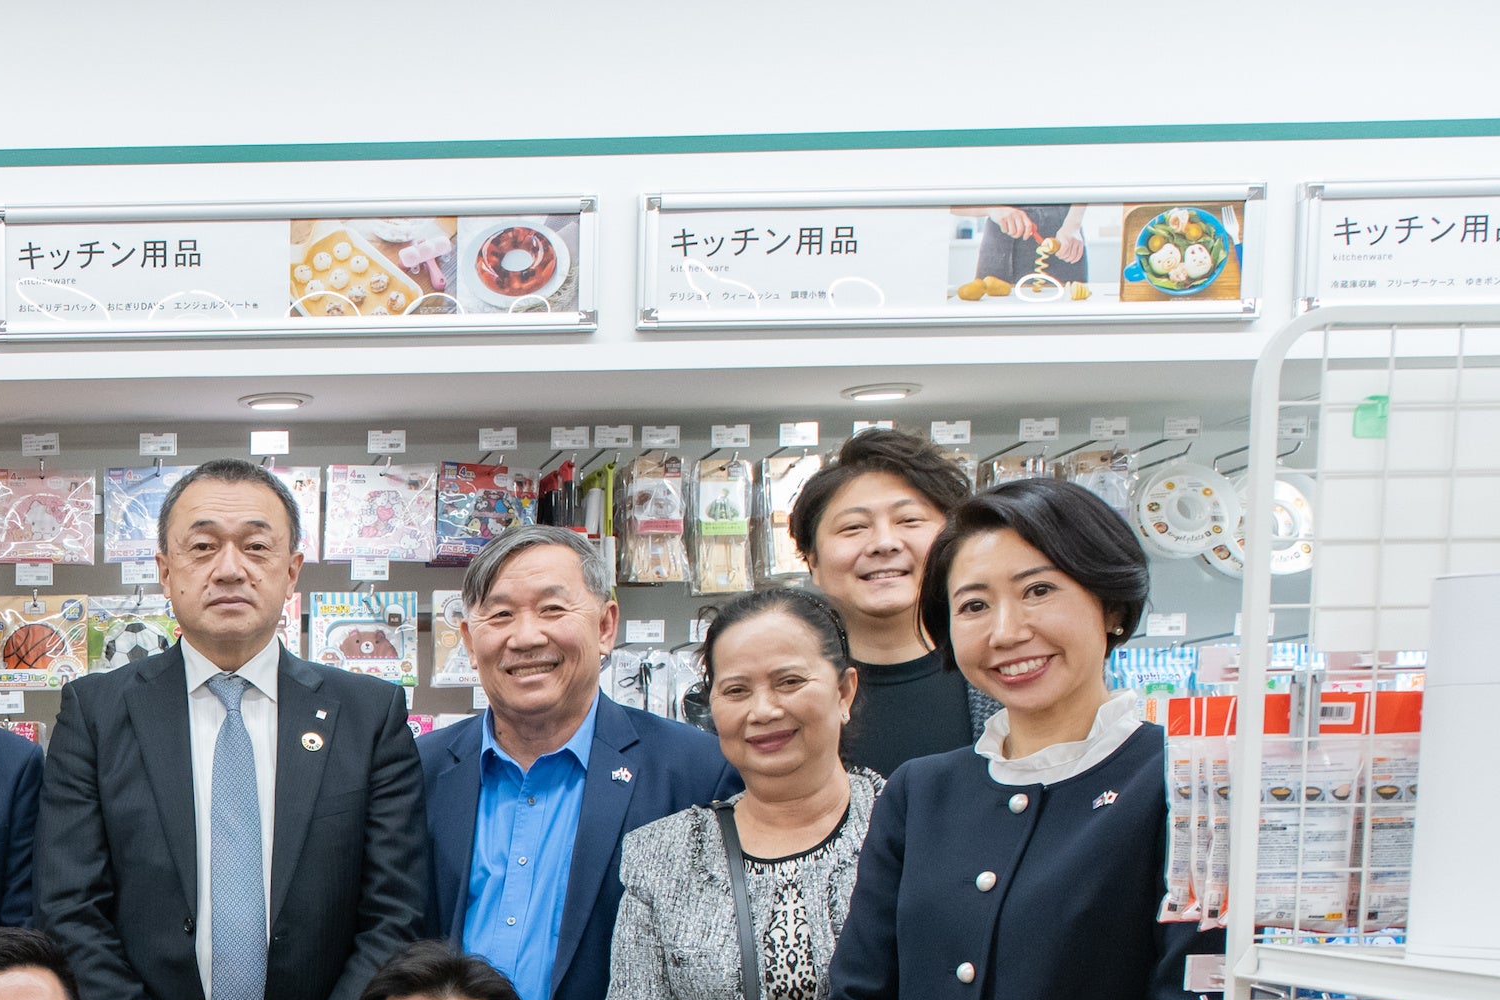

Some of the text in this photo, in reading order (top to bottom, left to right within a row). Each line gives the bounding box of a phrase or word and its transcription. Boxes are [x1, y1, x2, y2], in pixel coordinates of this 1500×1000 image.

[1333, 214, 1500, 246] キッチン用
[671, 226, 858, 257] キッチン用品
[18, 239, 201, 271] キッチン用品
[1332, 253, 1394, 261] kitchenware
[670, 264, 730, 272] kitheware
[1387, 277, 1456, 287] フリーザーケース
[790, 291, 835, 299] 調理小物
